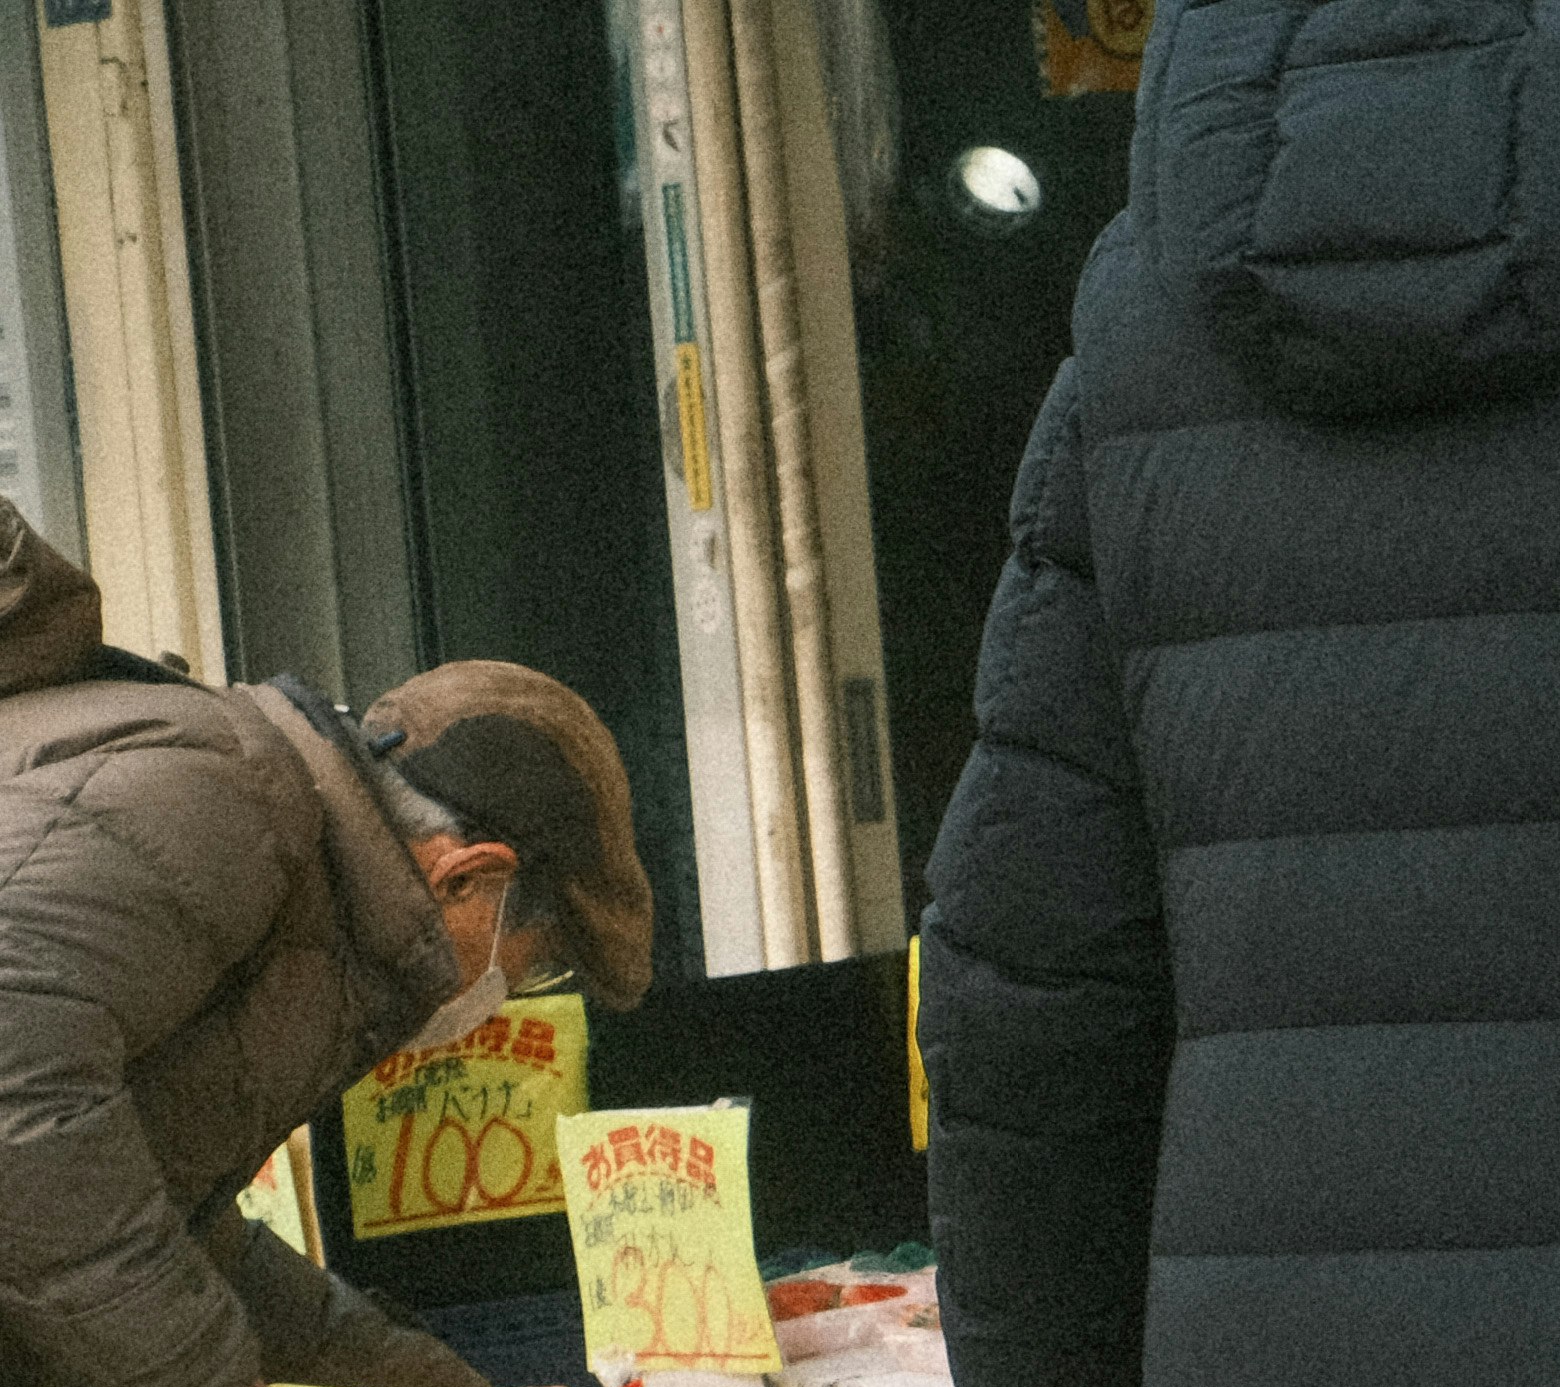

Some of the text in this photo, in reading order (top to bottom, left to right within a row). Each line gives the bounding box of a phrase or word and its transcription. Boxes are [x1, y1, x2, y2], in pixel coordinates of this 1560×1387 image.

[389, 1114, 533, 1217] 100
[582, 1123, 714, 1192] お買得品
